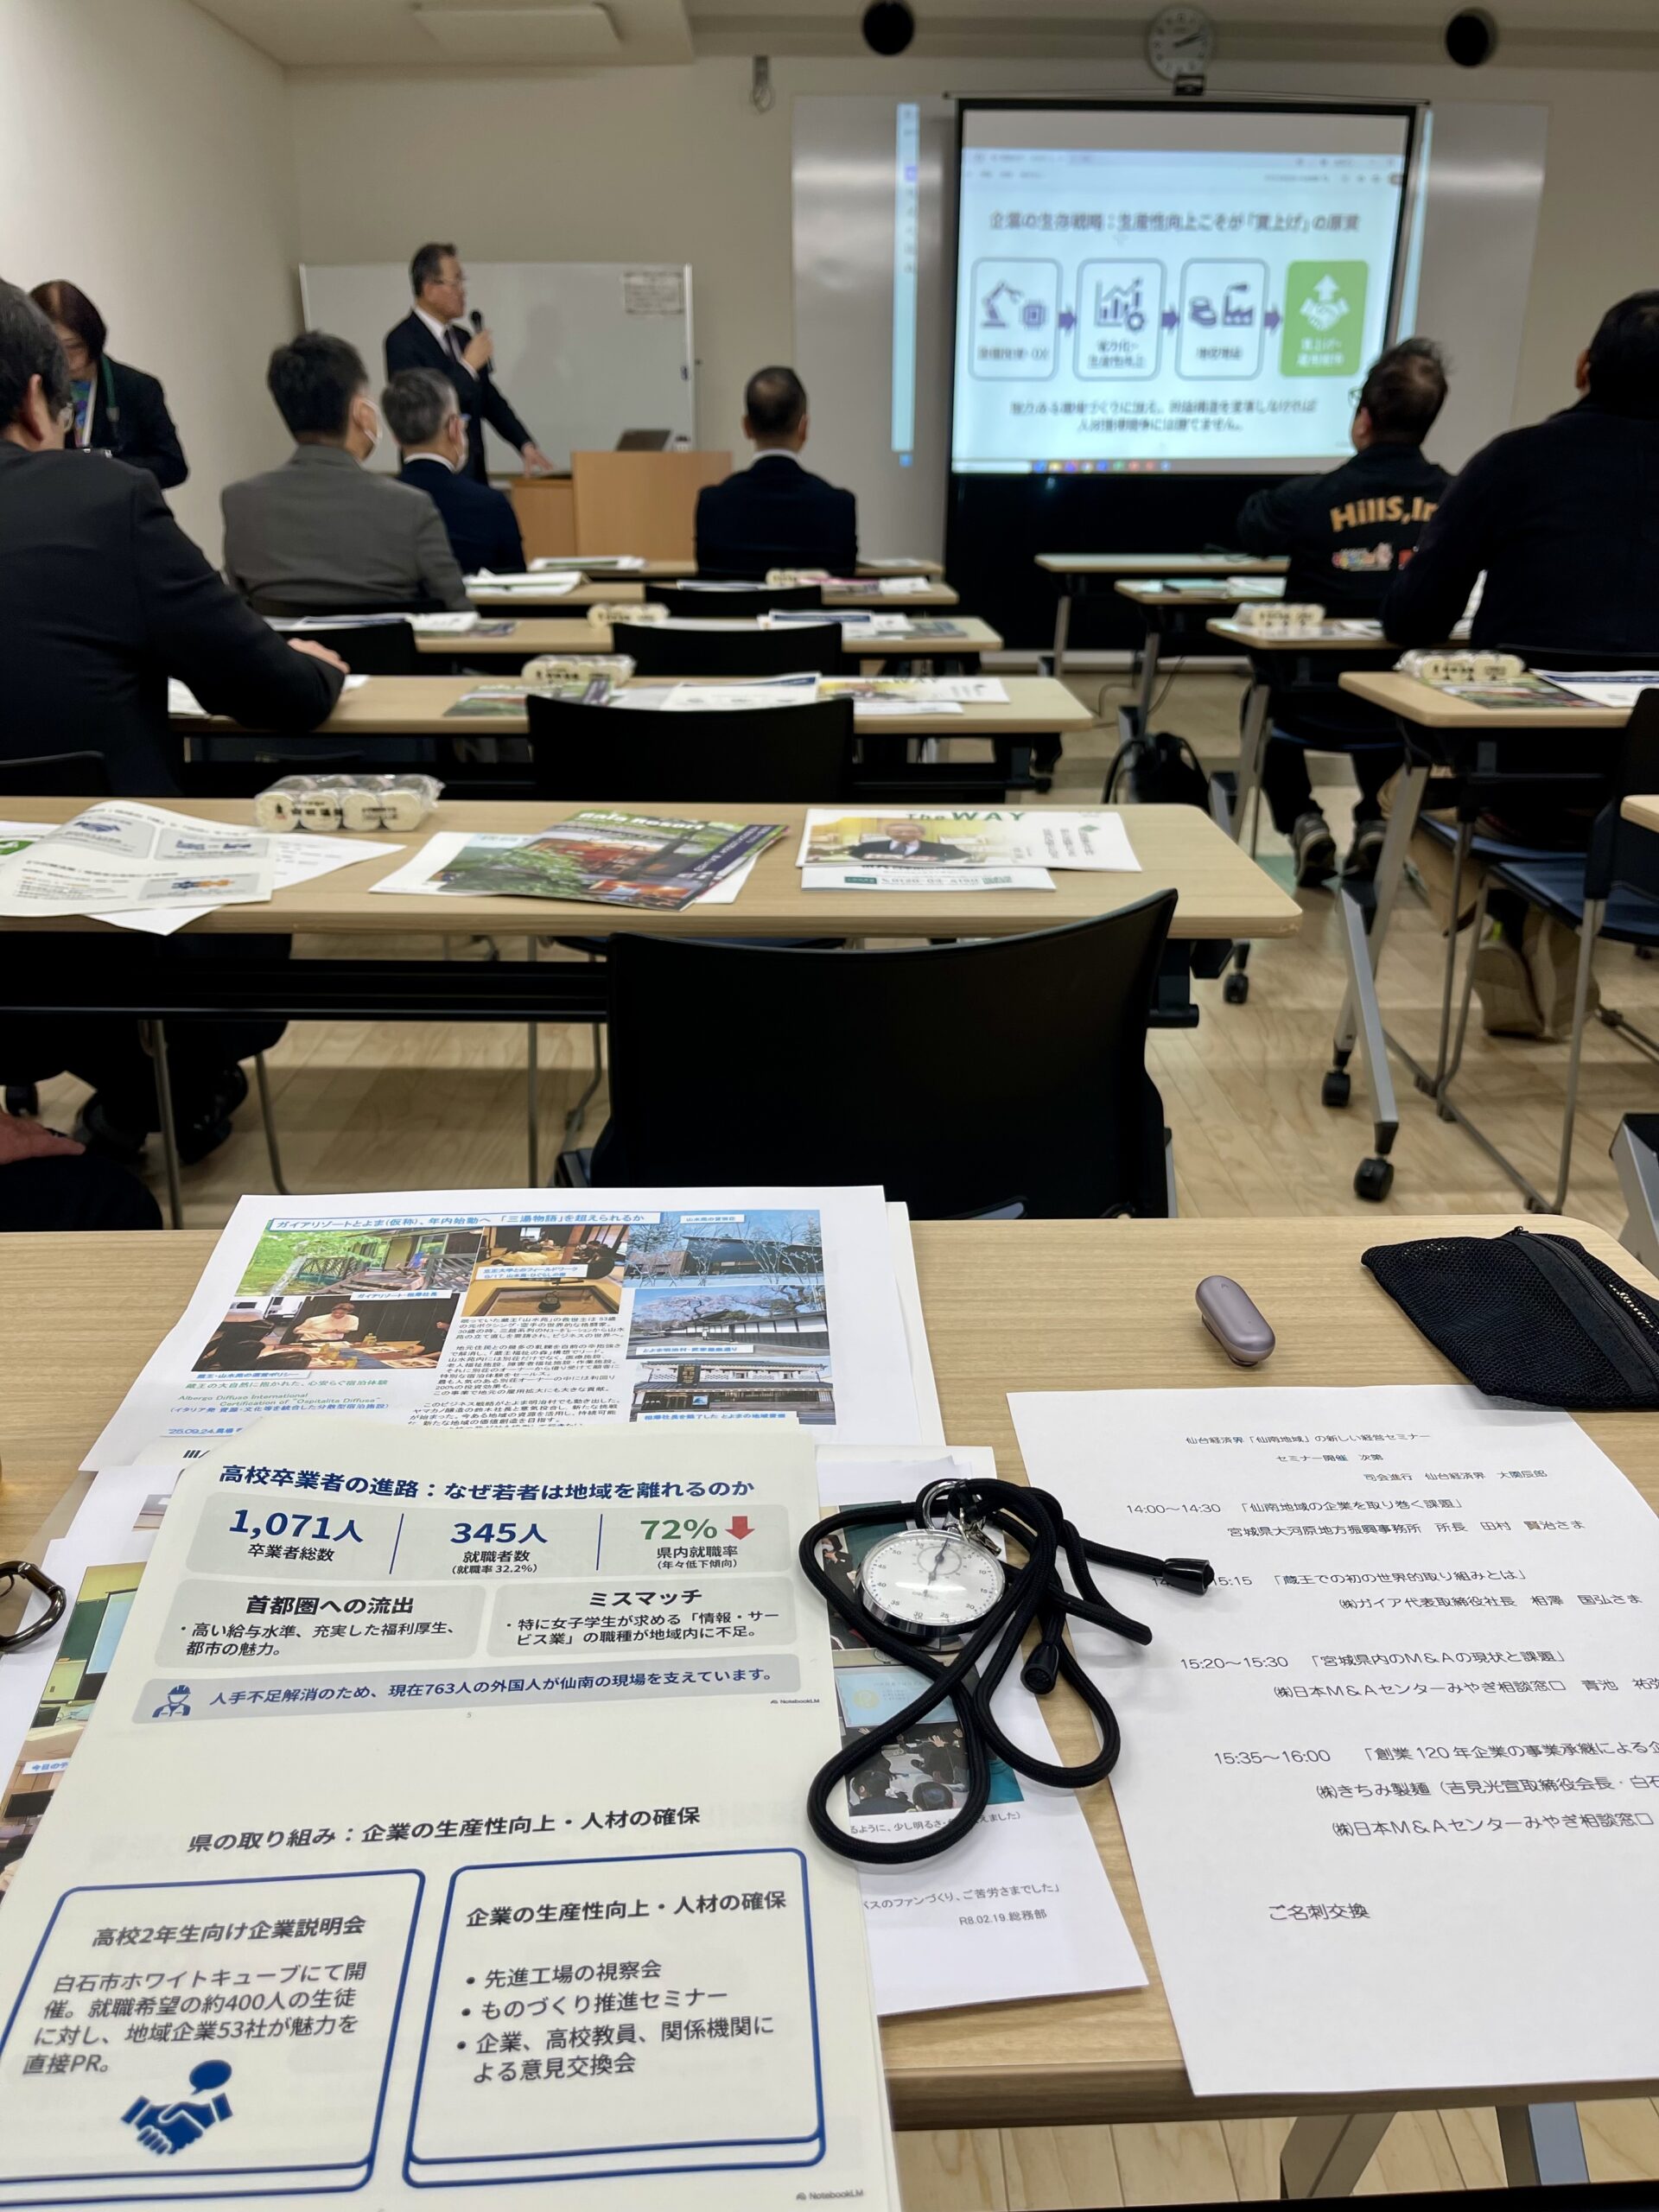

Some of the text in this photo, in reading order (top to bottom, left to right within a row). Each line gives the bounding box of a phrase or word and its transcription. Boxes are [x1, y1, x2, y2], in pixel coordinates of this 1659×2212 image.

[951, 811, 1027, 822] WAY
[1185, 1433, 1432, 1446] 仙台経済界「仙南地域」の新しい経営セミナー
[1276, 1453, 1384, 1463] セミナー開催 次第
[219, 1465, 755, 1500] 高校卒業者の進路：なぜ若者は地域を離れるのか
[1363, 1472, 1414, 1483] 司会進行
[1424, 1471, 1486, 1482] 仙台経済界
[1242, 1497, 1463, 1515] 「仙南地域の企業を取り巻く課題」
[229, 1509, 364, 1543] 1,071人
[450, 1522, 548, 1545] 345人
[640, 1519, 718, 1541] 72%
[1228, 1519, 1586, 1537] 宮城県大河原地方振興事務所 所長 田村 賢治さま
[247, 1543, 335, 1562] 卒業者総数
[463, 1549, 531, 1563] 就職者数
[656, 1545, 739, 1560] 県内就職率
[1273, 1568, 1527, 1587] 「蔵王での初の世界的取り組みとは」
[245, 1595, 414, 1616] 首都圏への流出
[588, 1588, 702, 1608] ミスマッチ
[1531, 1594, 1565, 1607] 相澤
[1580, 1593, 1643, 1606] 国弘さま
[517, 1625, 757, 1647] ビス業」の職種が地域内に不足。
[186, 1640, 282, 1657] 都市の魅力。
[209, 1668, 772, 1707] 人手不足解消のため、現在763人の外国人が仙南の現場を支えています。
[1580, 1679, 1620, 1693] 青池
[188, 1806, 702, 1853] 県の取り組み：企業の生産性向上・人材の確保
[465, 1891, 787, 1928] 企業の生産性向上・人材の確保
[958, 1909, 1047, 1927] R8.02.19.総務部
[1268, 1903, 1371, 1922] ご名刺交換
[92, 1915, 366, 1948] 高校2年生向け企業説明会
[54, 1961, 367, 1994] 白石市ホワイトキューブにて開
[484, 1960, 663, 1989] 先進工場の視察会
[44, 1987, 357, 2020] 催。就職希望の約400人の生徒
[481, 1988, 729, 2021] ものづくり推進セミナー
[34, 2014, 359, 2046] に対し、地域企業53社が魅力を
[475, 2016, 775, 2056] 企業、高校教員、関係機関に
[22, 2052, 110, 2075] 直接PR。
[473, 2051, 637, 2085] よる意見交換会
[809, 2188, 864, 2202] NotebookLM
